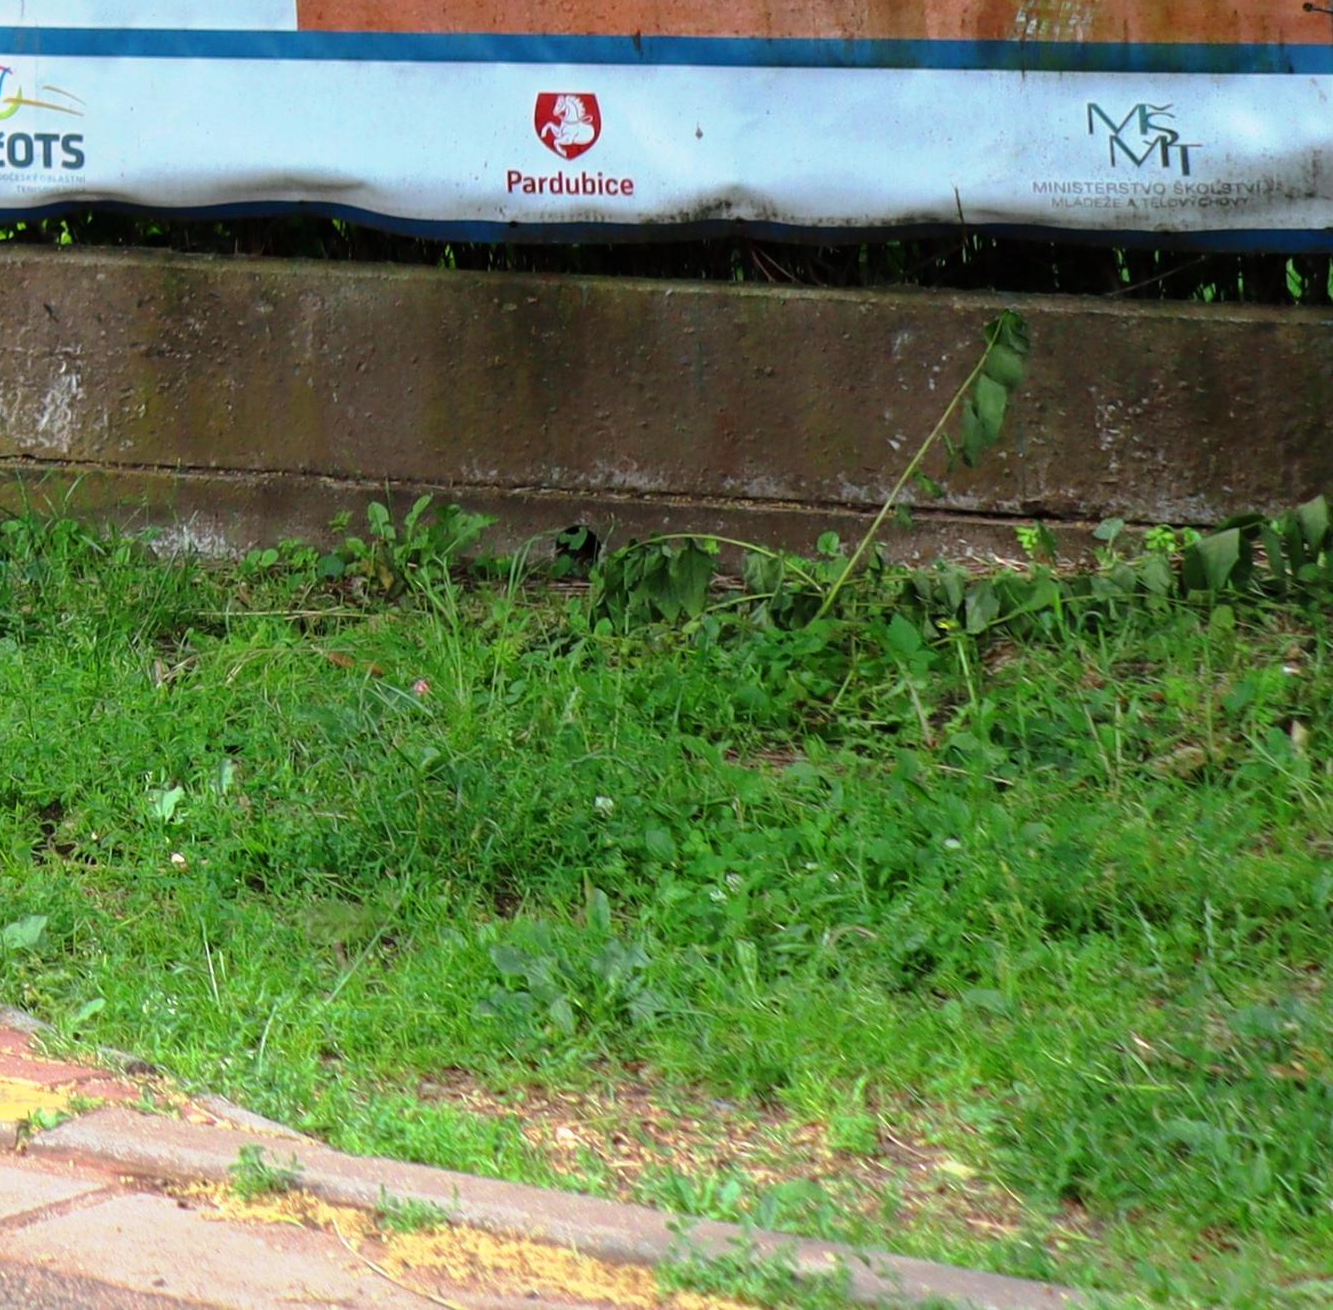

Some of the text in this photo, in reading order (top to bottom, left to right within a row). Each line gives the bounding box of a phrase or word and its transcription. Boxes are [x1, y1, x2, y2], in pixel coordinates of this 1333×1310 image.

[506, 170, 634, 196] Pardubice
[1032, 180, 1167, 195] MINISTERSTVO
[1051, 195, 1122, 209] MLÁDEŽE
[1126, 196, 1137, 209] A
